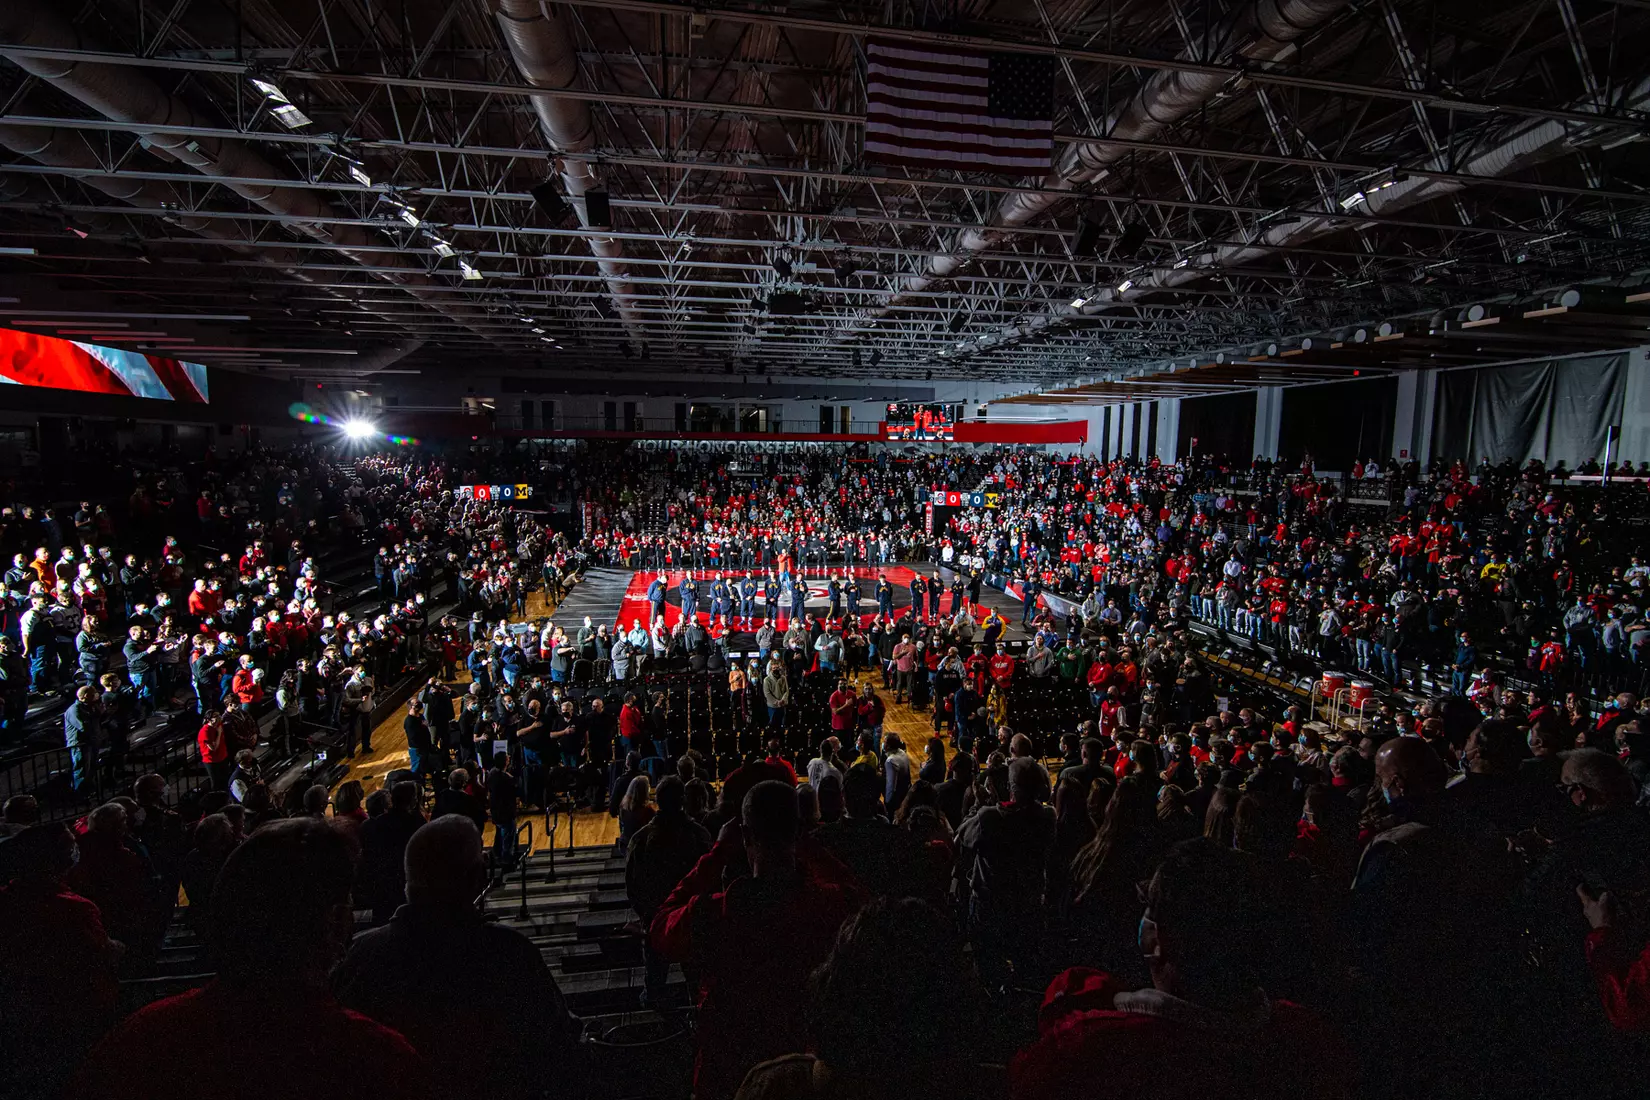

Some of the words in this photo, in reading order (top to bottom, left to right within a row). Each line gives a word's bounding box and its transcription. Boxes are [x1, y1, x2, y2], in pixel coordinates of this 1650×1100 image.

[686, 440, 748, 454] HONOR
[478, 488, 486, 498] 0
[504, 488, 511, 496] 0
[515, 487, 526, 496] M
[950, 495, 957, 503] 0
[974, 496, 980, 504] 0
[985, 496, 996, 504] M
